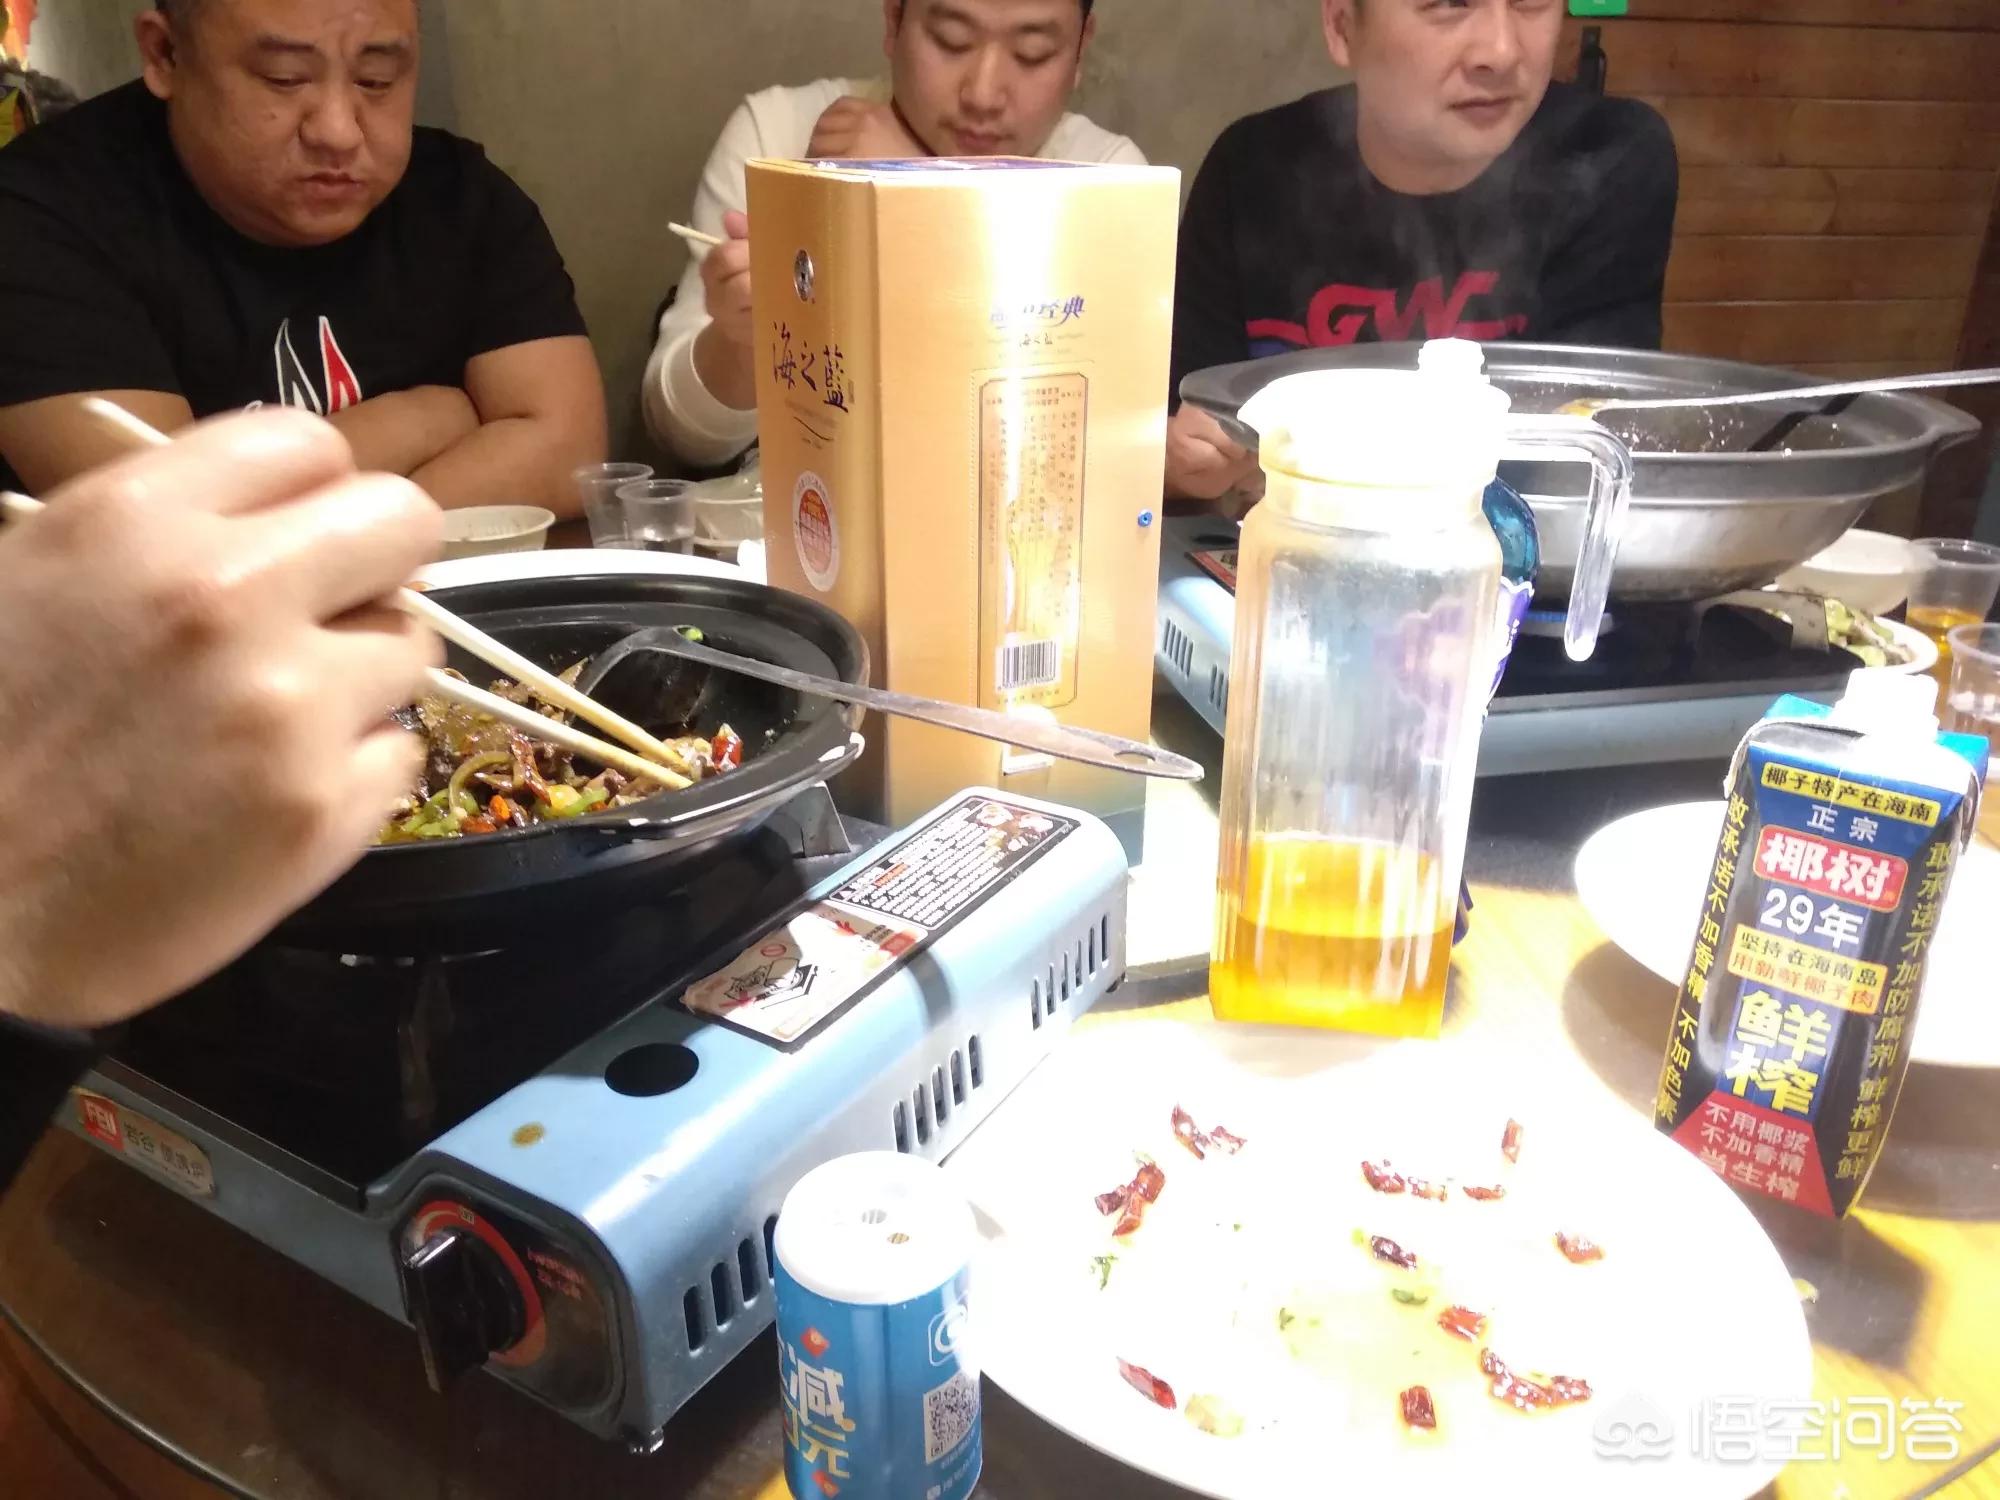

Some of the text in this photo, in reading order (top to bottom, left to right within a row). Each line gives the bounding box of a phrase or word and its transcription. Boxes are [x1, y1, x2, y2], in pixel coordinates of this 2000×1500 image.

[1765, 765, 1932, 822] 椰子特产在海南
[1806, 803, 1880, 844] 正宗
[1760, 831, 1891, 901] 椰树
[1687, 790, 1749, 1004] 敢承诺不加香精
[1758, 887, 1865, 949] 29年
[1733, 952, 1874, 1009] 用新鲜椰子肉
[1741, 931, 1878, 987] 坚持在海南岛
[1700, 1121, 1805, 1177] 不加香精
[1705, 1100, 1810, 1156] 不用椰浆
[1699, 1145, 1800, 1201] 当生榨
